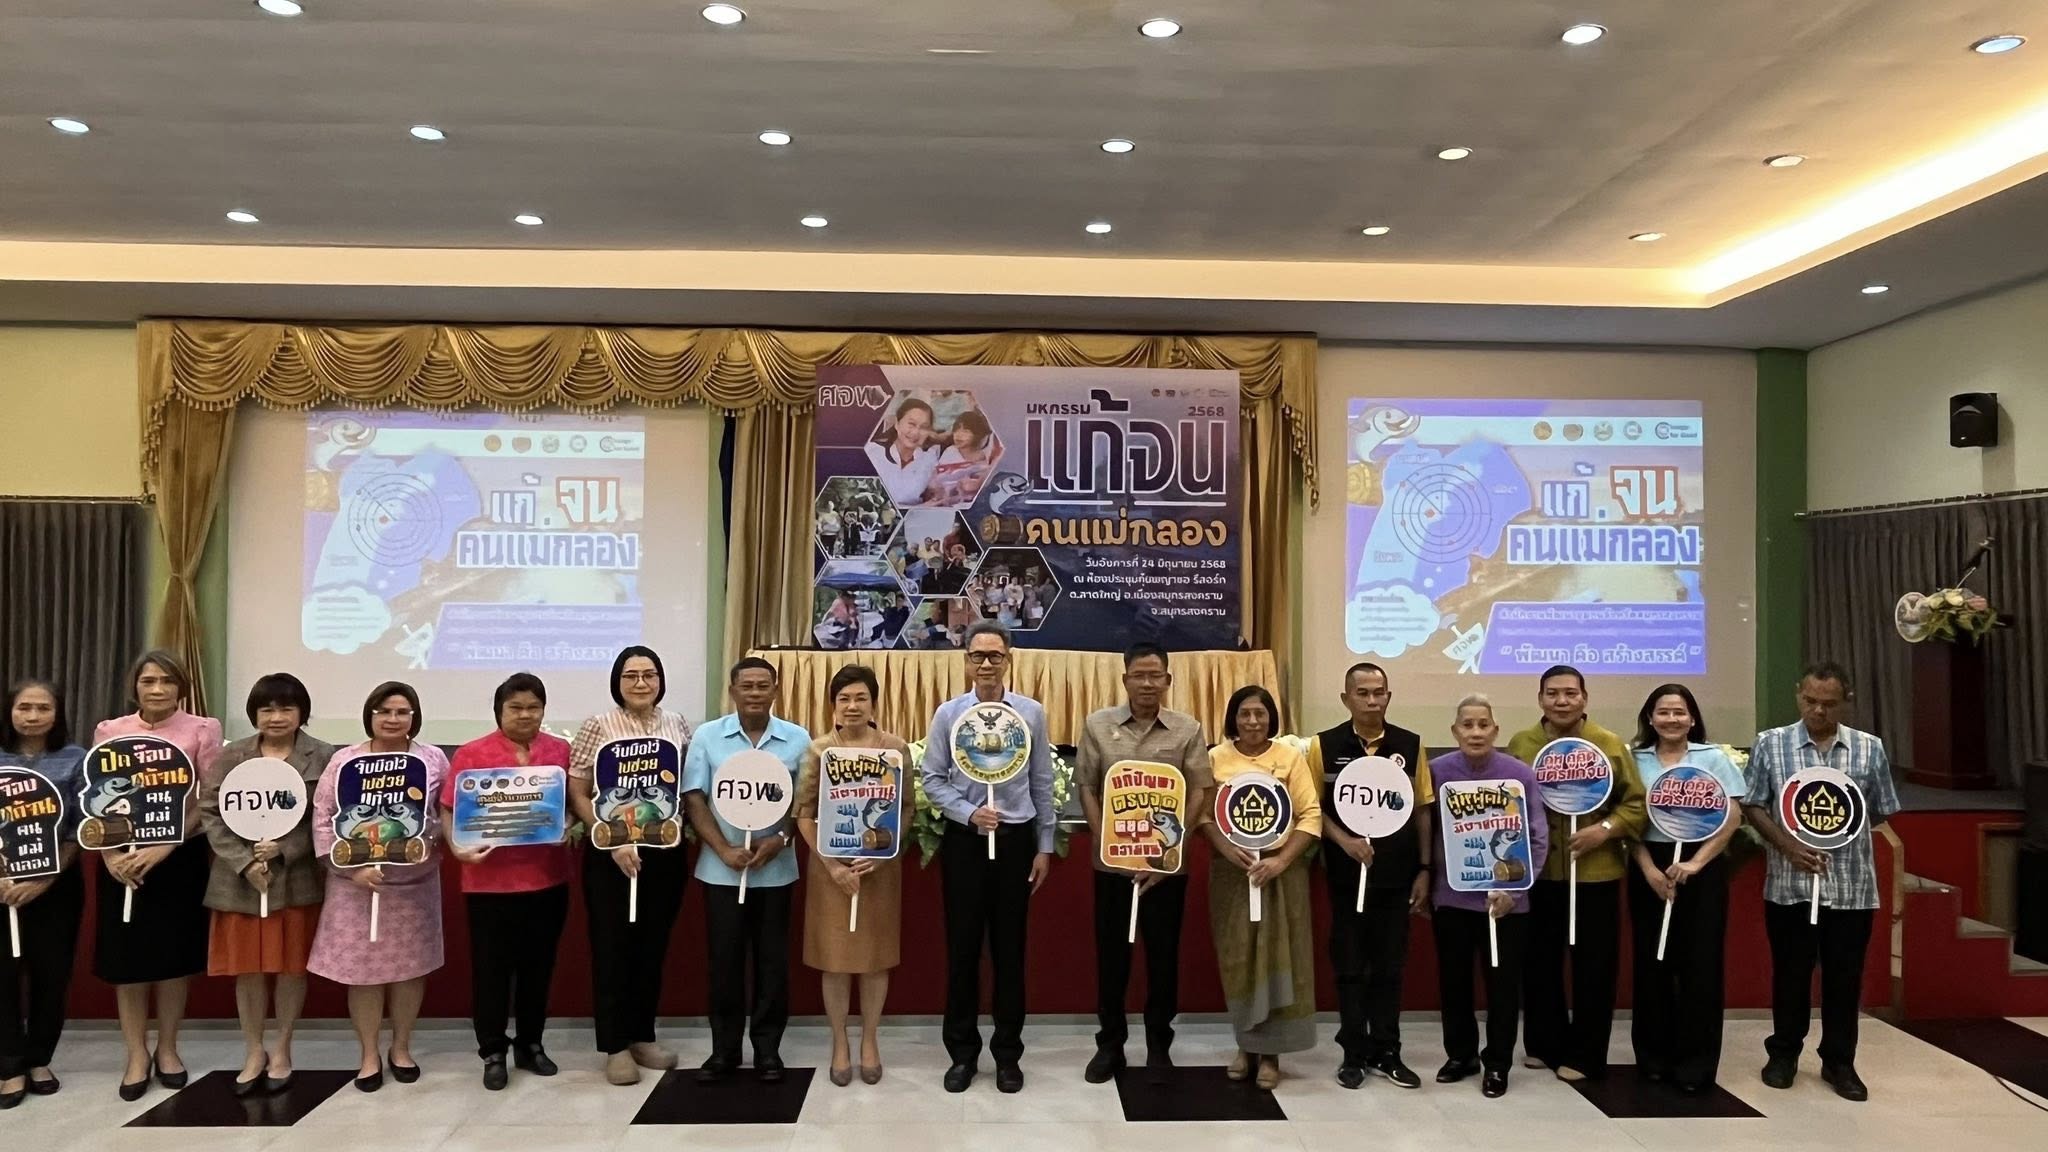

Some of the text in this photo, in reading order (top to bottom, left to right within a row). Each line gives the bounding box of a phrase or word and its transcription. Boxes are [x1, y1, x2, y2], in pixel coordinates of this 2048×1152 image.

[1026, 403, 1091, 415] มหกรรม
[1188, 406, 1225, 417] 2568
[1026, 388, 1227, 495] แก้จน
[1026, 506, 1227, 546] คนแม่กลอง
[1086, 554, 1226, 571] วันอังคารที่ 24 มิถุนายน 2568
[1073, 576, 1084, 584] ณ
[610, 739, 660, 758] จับมือไว้
[354, 755, 408, 775] จับมือไว้
[146, 790, 172, 803] คน
[17, 822, 43, 836] คน
[135, 825, 175, 838] กลอง
[10, 857, 50, 873] กลอง
